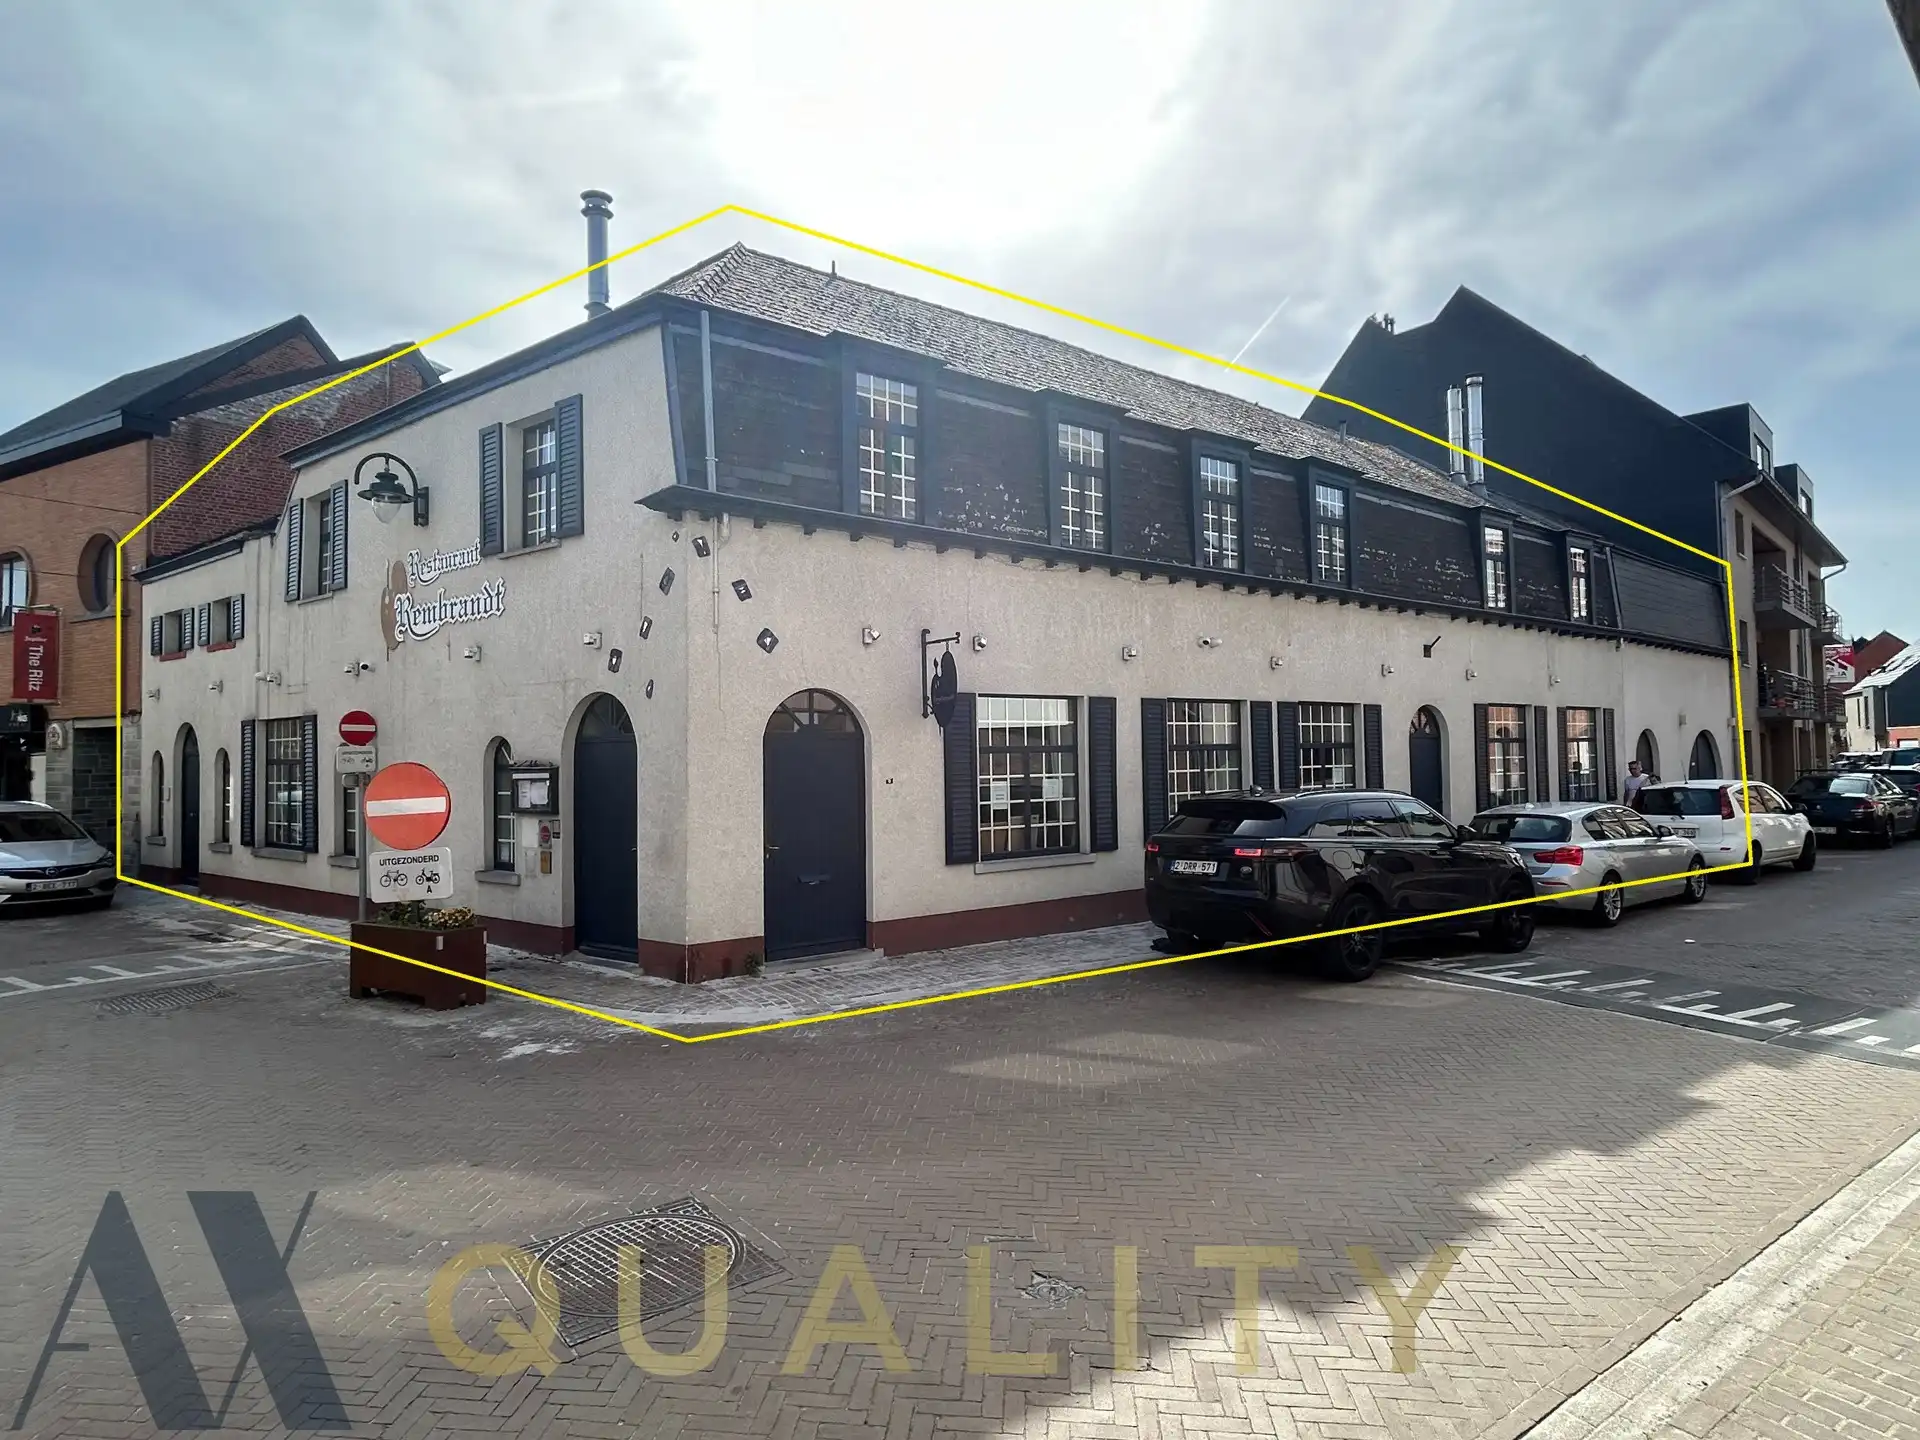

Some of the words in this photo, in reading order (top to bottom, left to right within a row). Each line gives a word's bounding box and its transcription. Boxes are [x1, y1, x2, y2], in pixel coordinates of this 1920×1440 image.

[407, 538, 481, 586] Restaurant
[394, 577, 506, 641] Rembrandt
[28, 645, 44, 666] The
[28, 669, 44, 691] Ritz
[379, 854, 440, 866] UITGEZONDERD
[426, 885, 433, 894] A
